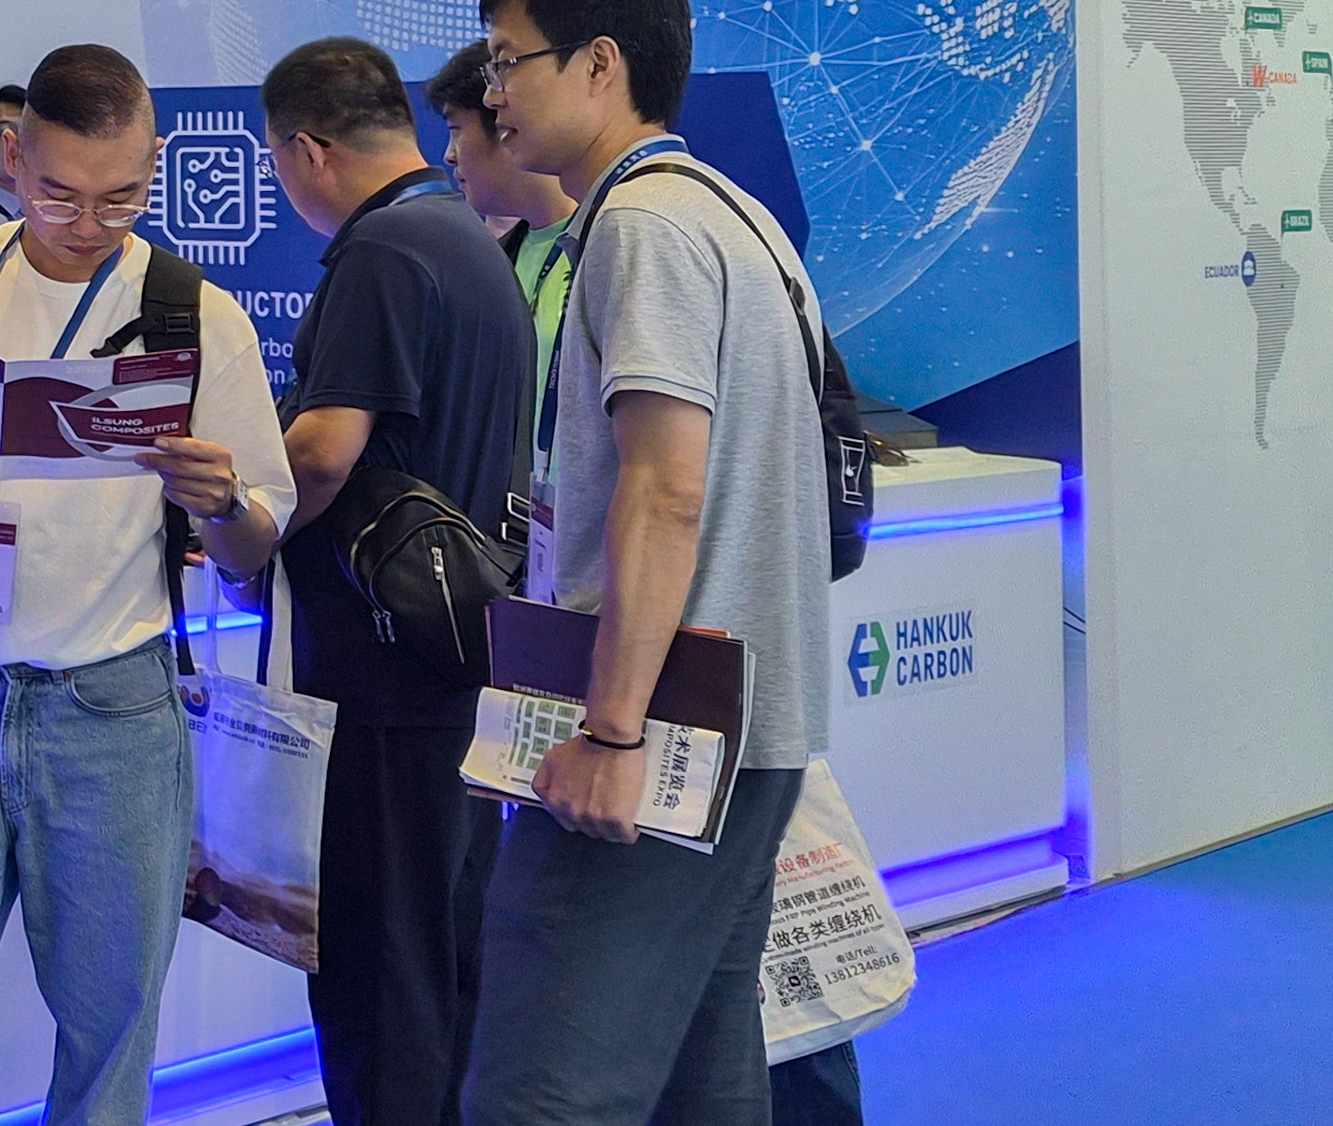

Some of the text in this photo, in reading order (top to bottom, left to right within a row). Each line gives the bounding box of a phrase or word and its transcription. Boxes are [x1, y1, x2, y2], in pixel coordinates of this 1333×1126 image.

[90, 421, 180, 435] COMPOSITES
[896, 610, 974, 651] HANKUK
[896, 645, 973, 686] CARBON
[824, 952, 901, 985] 13812348616
